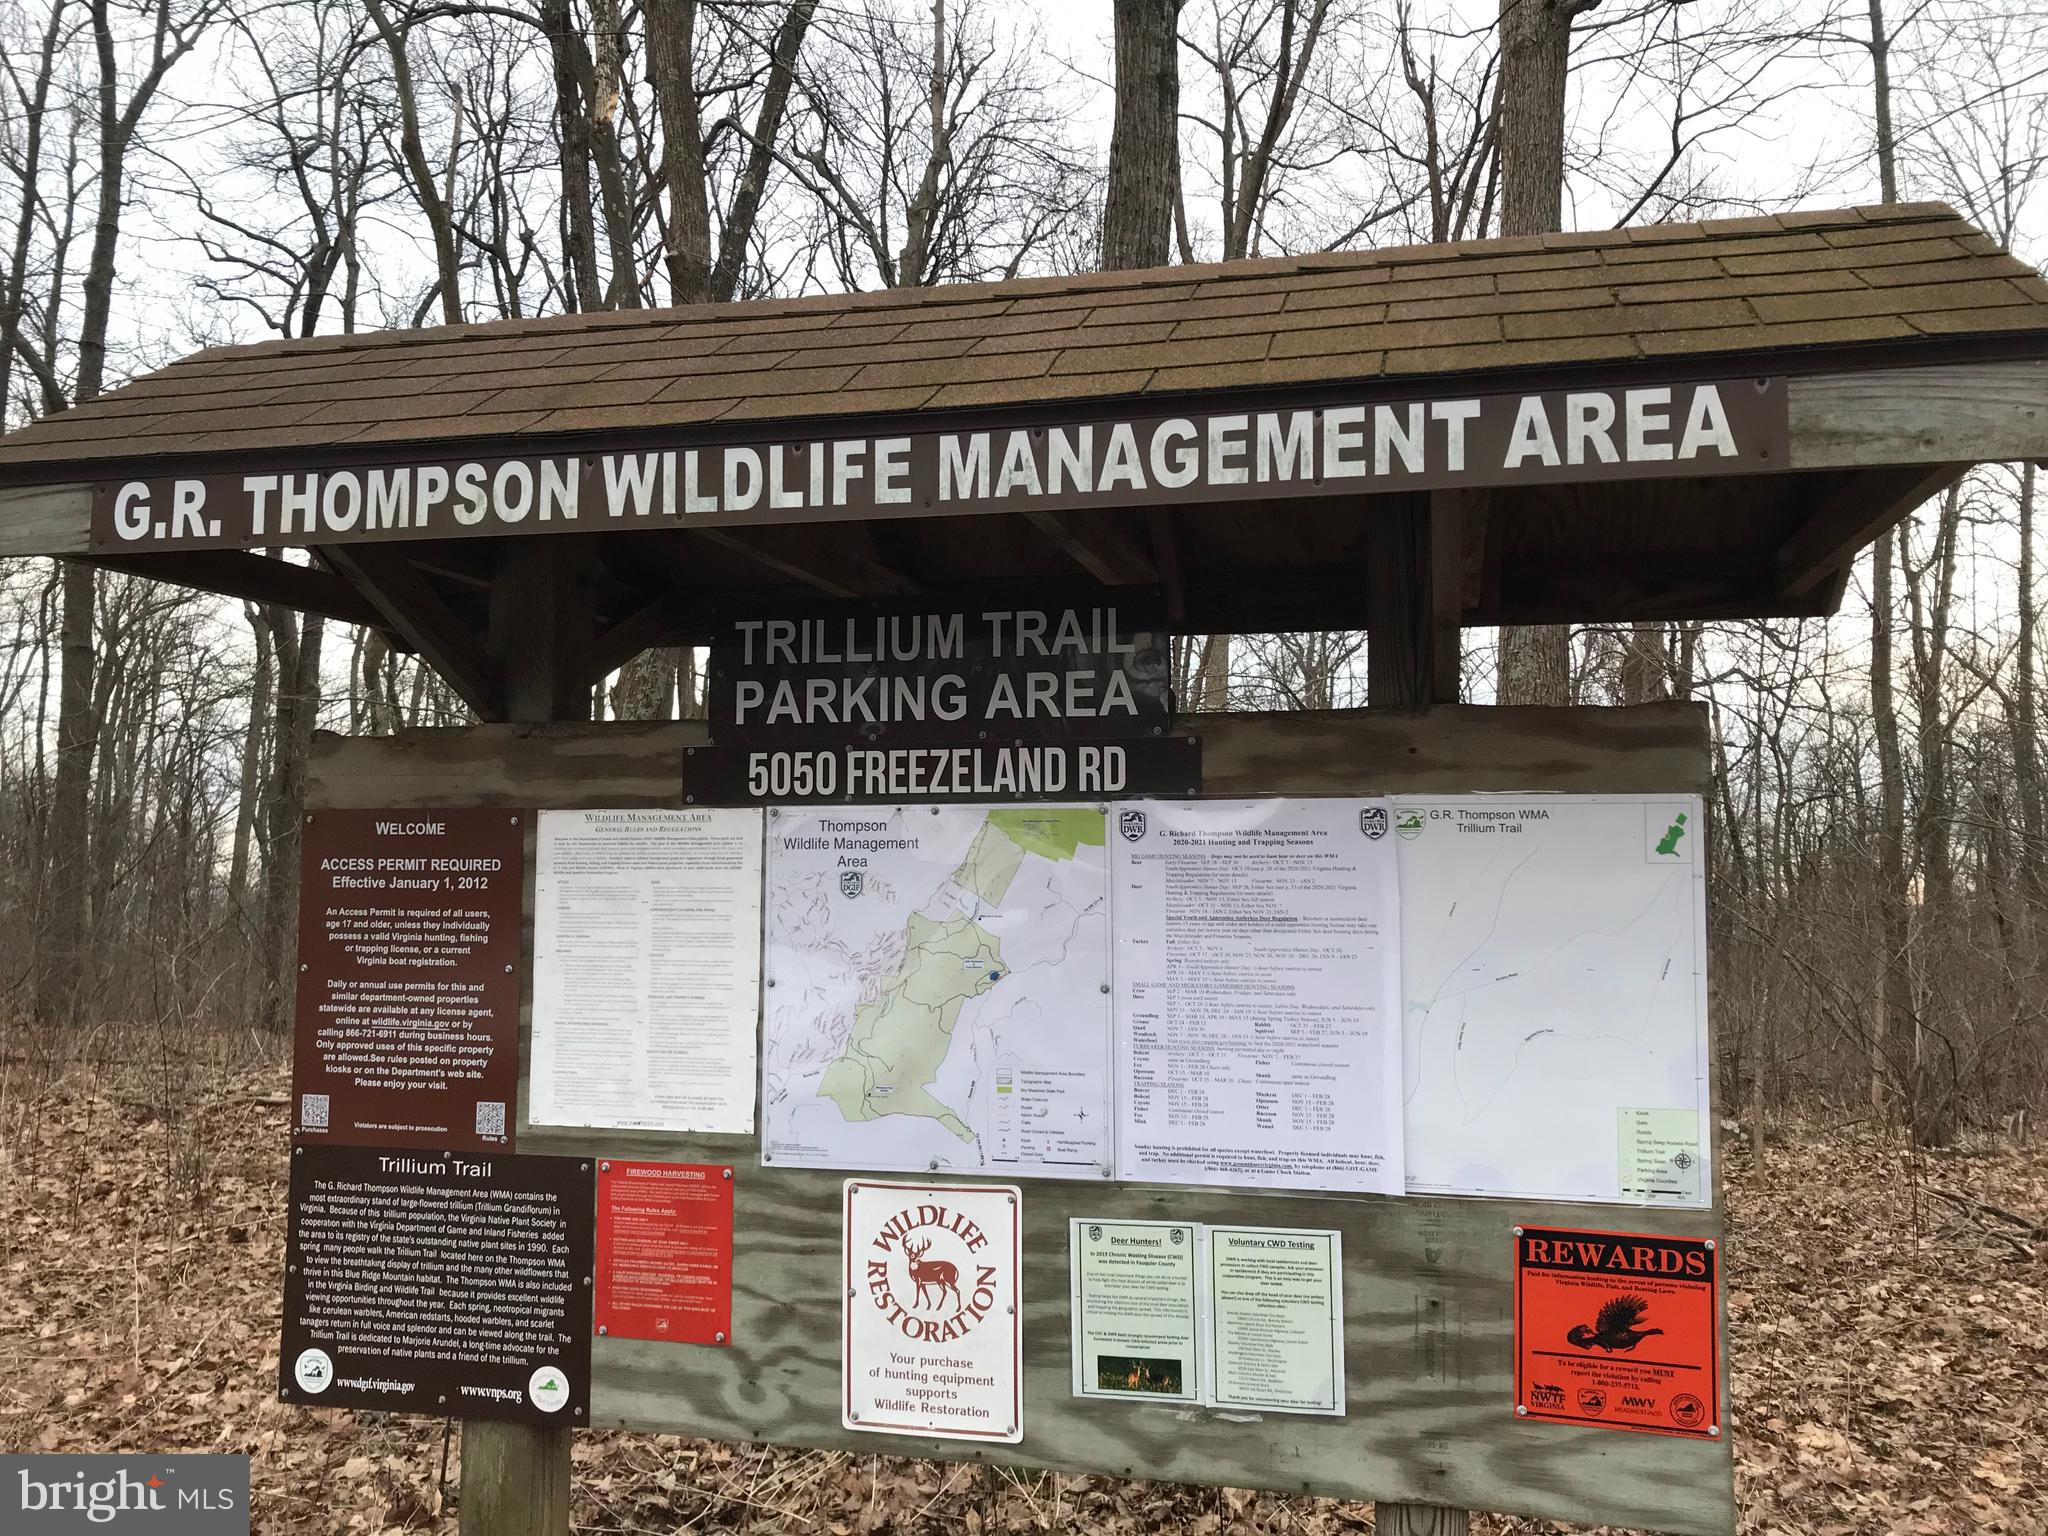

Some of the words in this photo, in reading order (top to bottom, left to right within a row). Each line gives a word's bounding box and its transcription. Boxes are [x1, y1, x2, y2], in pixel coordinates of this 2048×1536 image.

[114, 480, 221, 540] G.R.
[243, 458, 579, 534] THOMPSON
[602, 438, 911, 517] WILDLIFE
[939, 400, 1480, 501] MANAGEMENT
[1503, 385, 1738, 468] AREA
[735, 614, 963, 665] TRILLIUM
[982, 608, 1136, 659] TRAIL
[736, 674, 966, 725] PARKING
[985, 670, 1142, 719] AREA
[749, 751, 836, 796] 5050
[846, 748, 1066, 797] FREEZELAND
[1079, 746, 1126, 791] RD
[585, 814, 624, 823] WILDLIFE
[628, 813, 687, 823] MANAGEMENT
[690, 813, 712, 822] AREA
[1430, 810, 1454, 819] G.R.
[1458, 810, 1515, 822] Thompson
[1518, 810, 1549, 819] WMA
[376, 822, 445, 835] WELCOME
[819, 820, 887, 834] Thompson
[1123, 824, 1144, 834] DWR
[1363, 822, 1386, 831] DWR
[1457, 823, 1495, 833] Trillium
[1499, 823, 1522, 833] Trail
[784, 837, 829, 850] Wildlife
[834, 837, 919, 852] Management
[1253, 839, 1285, 847] Trapping
[321, 859, 374, 870] ACCESS
[378, 859, 427, 870] PERMIT
[431, 859, 501, 871] REQUIRED
[837, 855, 868, 867] Area
[333, 876, 386, 888] Effective
[389, 877, 440, 892] January
[444, 877, 454, 891] 1,
[458, 877, 488, 889] 2012
[326, 907, 337, 915] An
[339, 907, 367, 916] Access
[370, 908, 396, 916] Permit
[398, 908, 405, 916] is
[407, 909, 440, 918] required
[443, 909, 451, 917] of
[453, 909, 462, 917] all
[326, 921, 340, 929] age
[353, 920, 368, 928] and
[370, 920, 392, 929] older,
[395, 921, 421, 929] unless
[423, 921, 441, 931] they
[443, 921, 490, 932] individually
[329, 933, 361, 941] possess
[371, 932, 390, 940] valid
[392, 933, 422, 943] Virginia
[425, 933, 458, 943] hunting,
[460, 934, 488, 944] fishing
[356, 944, 388, 954] trapping
[391, 945, 421, 954] license,
[357, 956, 387, 966] Virginia
[389, 957, 407, 965] boat
[409, 958, 457, 967] registration.
[336, 1016, 360, 1025] online
[463, 1020, 473, 1030] by
[318, 1028, 343, 1038] calling
[399, 1030, 425, 1041] during
[428, 1031, 464, 1040] business
[467, 1033, 493, 1041] hours.
[355, 1078, 381, 1087] Please
[383, 1079, 406, 1090] enjoy
[408, 1082, 426, 1090] your
[428, 1081, 447, 1089] visit.
[379, 1157, 445, 1174] Trillium
[453, 1161, 491, 1177] Trail
[314, 1180, 326, 1189] The
[328, 1181, 335, 1190] G.
[337, 1182, 362, 1191] Richard
[364, 1183, 398, 1194] Thompson
[400, 1185, 424, 1195] Wildlife
[426, 1187, 471, 1197] Management
[472, 1189, 488, 1198] Area
[490, 1190, 512, 1200] (WMA)
[514, 1192, 544, 1201] contains
[546, 1193, 557, 1202] the
[872, 1204, 989, 1254] WILDLIFE
[1111, 1237, 1128, 1245] Deer
[1130, 1238, 1161, 1247] Hunters!
[1229, 1238, 1266, 1248] Voluntary
[1268, 1240, 1286, 1248] CWD
[1286, 1241, 1315, 1250] Testing
[1525, 1238, 1706, 1276] REWARDS
[867, 1259, 997, 1343] RESTORATION
[890, 1353, 915, 1364] Your
[920, 1357, 973, 1368] purchase
[869, 1368, 880, 1377] of
[885, 1368, 928, 1383] hunting
[933, 1373, 994, 1386] equipment
[906, 1388, 957, 1400] supports
[875, 1399, 915, 1411] Wildlife
[922, 1403, 989, 1418] Restoration
